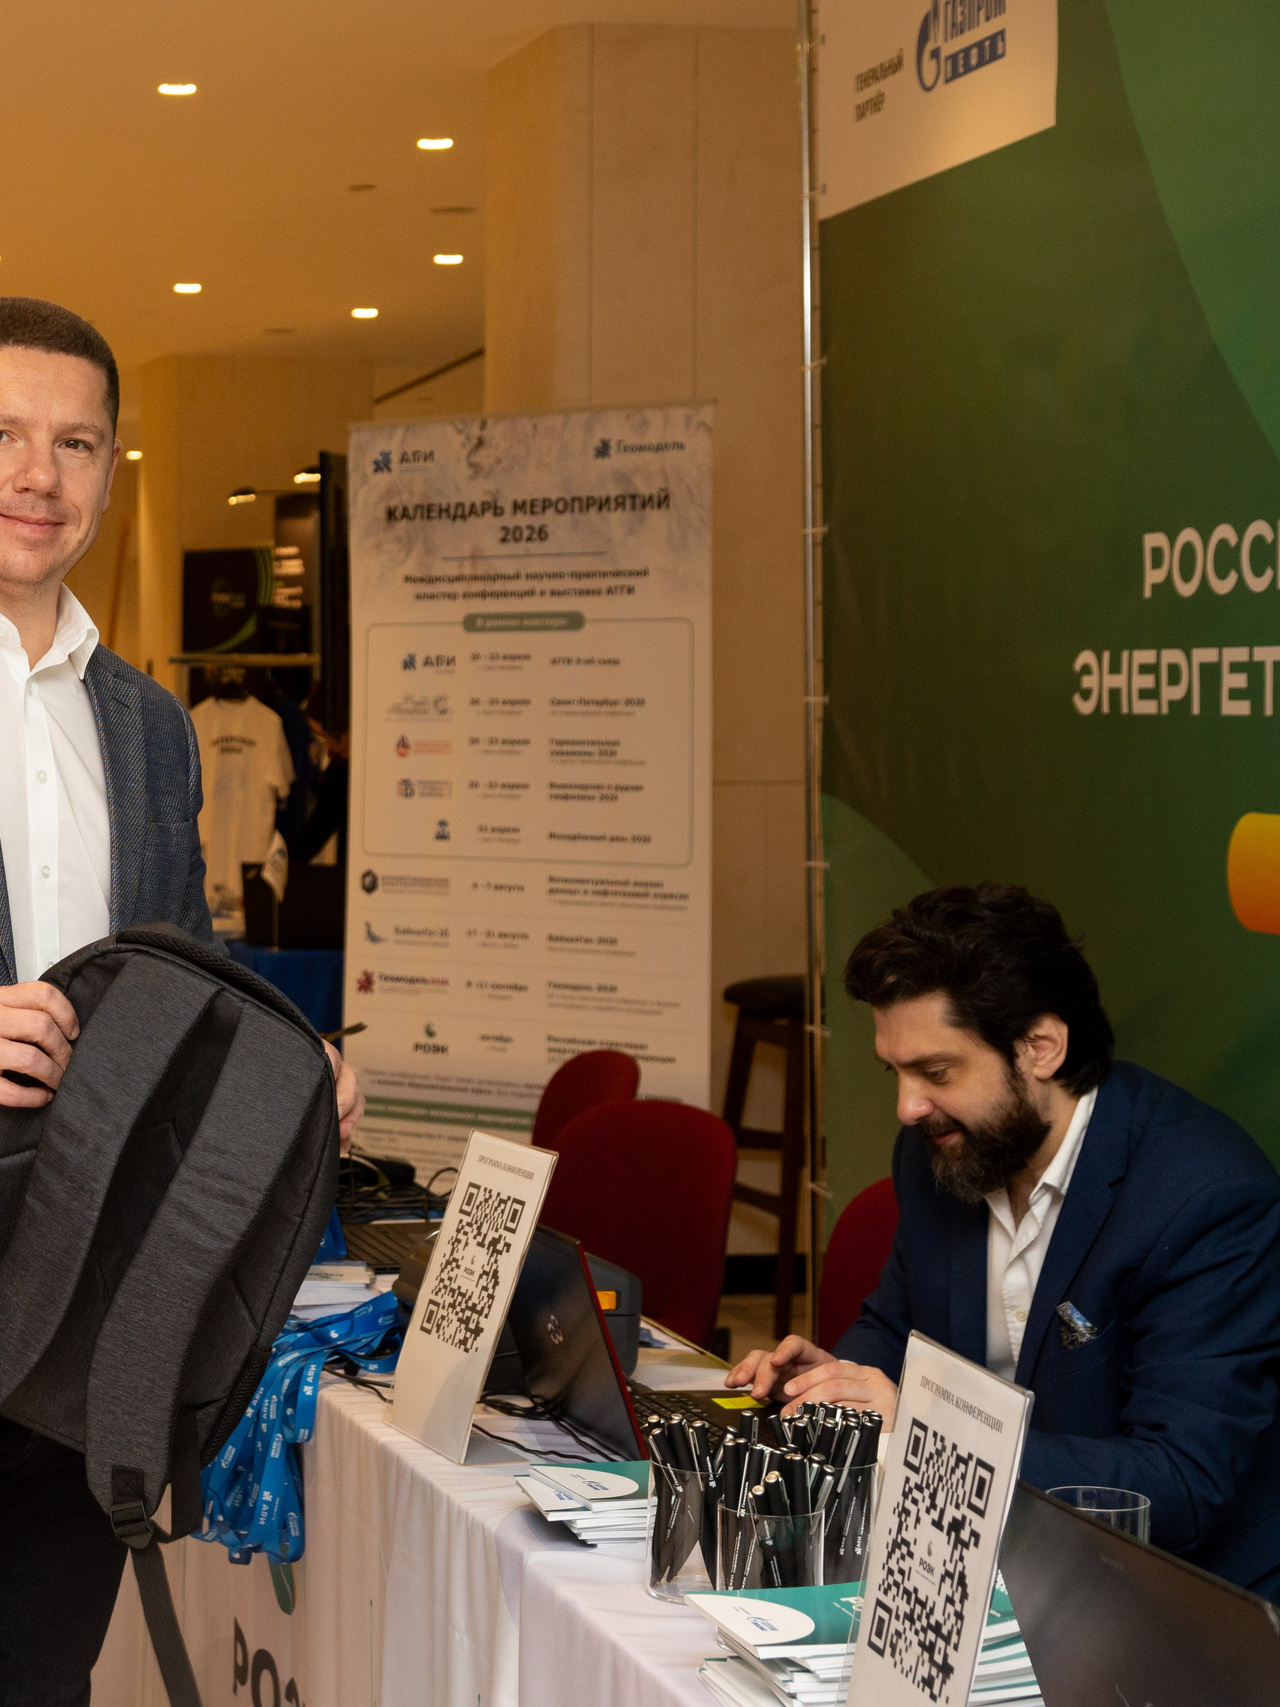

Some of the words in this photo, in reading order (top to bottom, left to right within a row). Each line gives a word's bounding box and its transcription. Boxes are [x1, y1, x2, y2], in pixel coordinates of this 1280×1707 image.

[856, 48, 904, 93] ГЕНЕРАЛЬНЫЙ
[856, 90, 886, 122] ПАРТНЁР
[617, 438, 686, 455] Геомодель
[386, 499, 505, 523] КАЛЕНДАРЬ
[512, 488, 671, 516] МЕРОПРИЯТИЙ
[499, 524, 549, 544] 2026
[1143, 519, 1280, 599] РОСС
[404, 571, 521, 585] Междисциплинарный
[525, 567, 649, 582] научно-практический
[415, 588, 459, 602] кластер
[462, 586, 536, 601] конференций
[1072, 646, 1280, 716] ЭНЕРГЕТ
[477, 1154, 503, 1170] ПРОГРАММА
[503, 1162, 535, 1180] КОНФЕРЕНЦИИ
[463, 1266, 475, 1277] РОЭК
[920, 1375, 955, 1406] ПРОГРАММА
[954, 1395, 1004, 1434] КОНФЕРЕНЦИИ
[919, 1557, 935, 1577] РОЭК
[233, 1616, 306, 1707] РО
